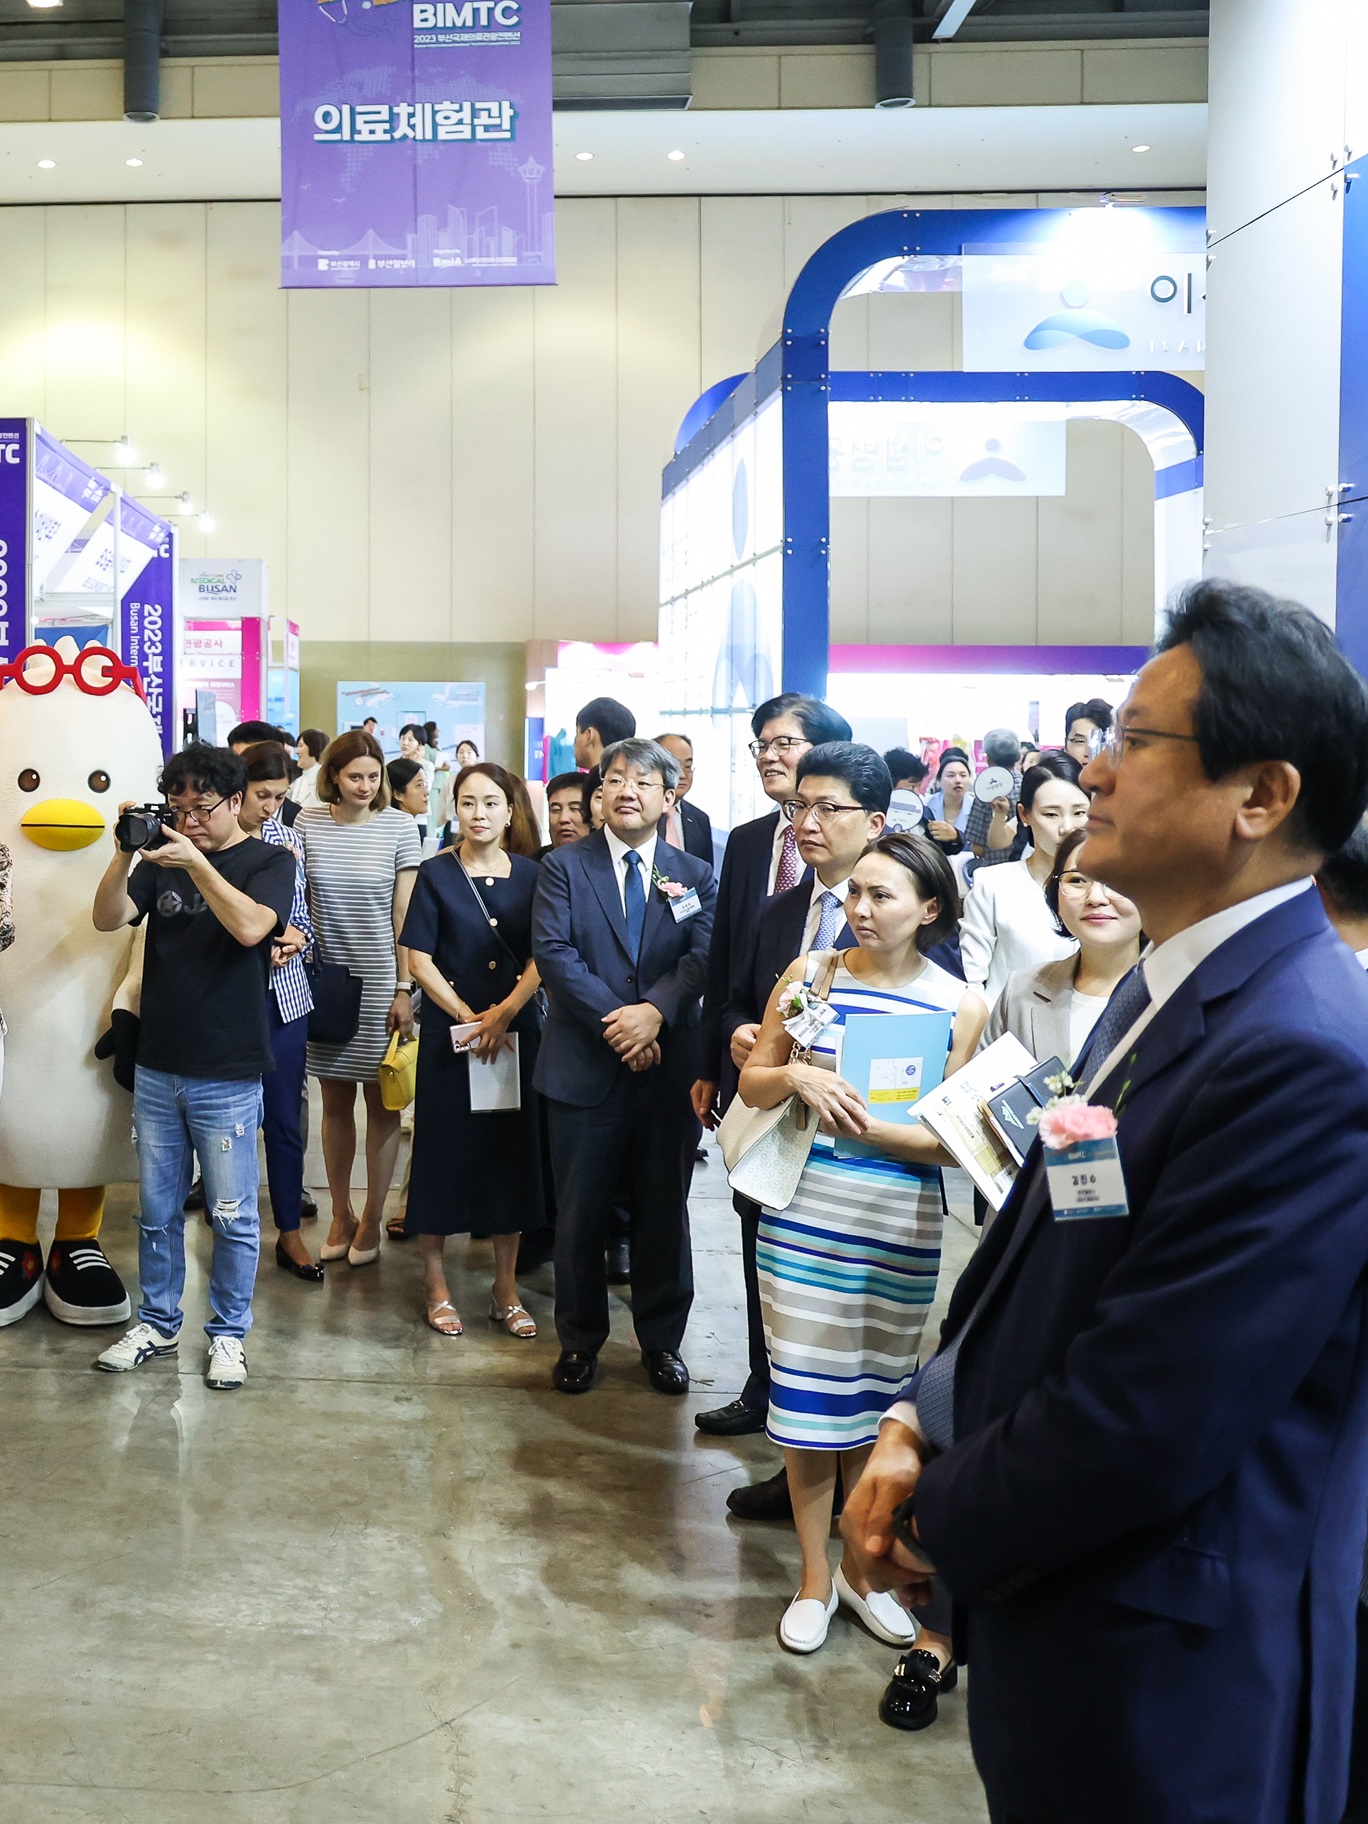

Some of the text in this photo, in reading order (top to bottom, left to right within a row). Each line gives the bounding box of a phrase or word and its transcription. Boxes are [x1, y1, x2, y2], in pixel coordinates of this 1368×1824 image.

[413, 1, 520, 28] BIMTC
[413, 34, 436, 43] 2023
[313, 100, 515, 142] 의료체험관
[198, 584, 237, 595] BUSAN
[130, 602, 141, 634] Busan
